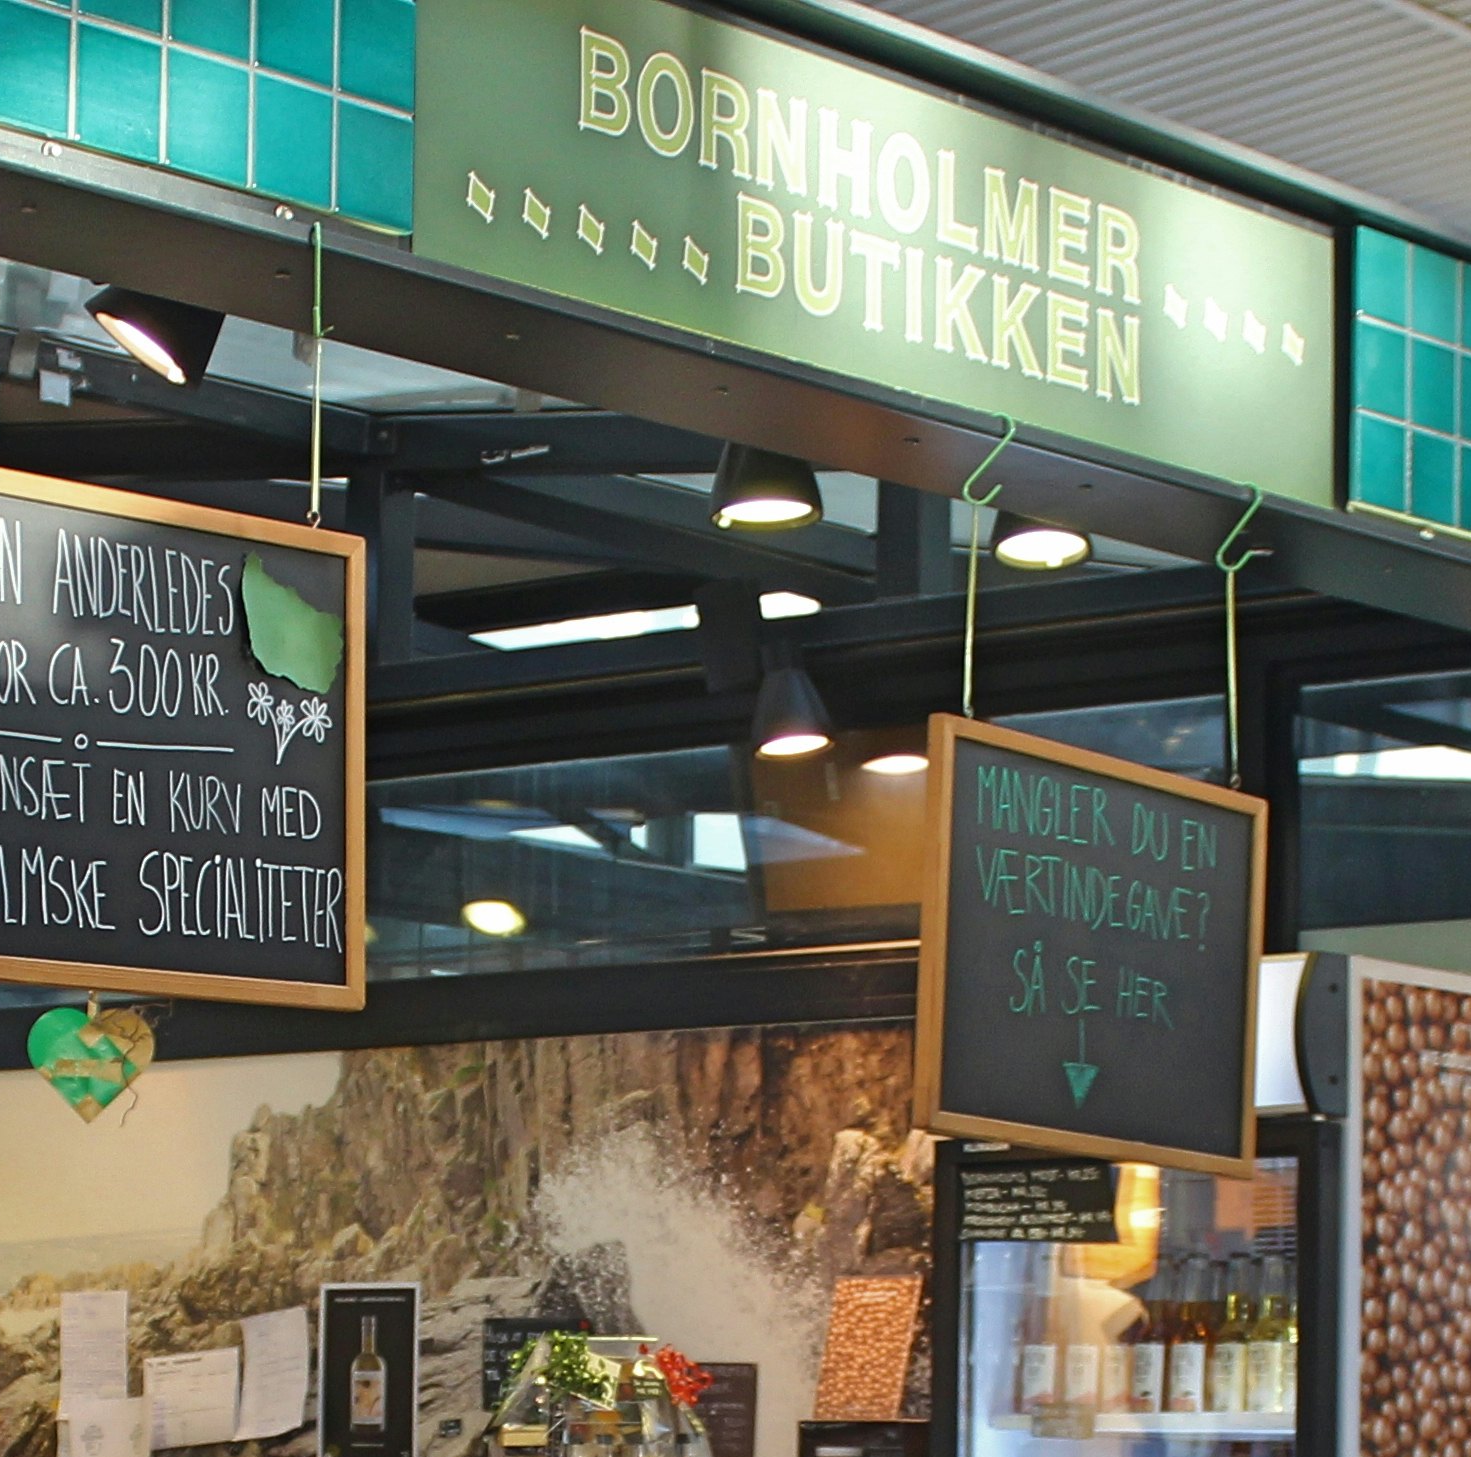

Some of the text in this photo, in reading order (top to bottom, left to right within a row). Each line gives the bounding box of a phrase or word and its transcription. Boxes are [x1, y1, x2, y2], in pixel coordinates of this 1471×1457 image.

[578, 25, 1141, 304] BORNHOLMER
[735, 192, 1140, 405] BUTIKKEN
[52, 528, 234, 637] ANDERLEDES
[48, 642, 99, 707] CA.
[108, 637, 183, 717] 300
[190, 652, 230, 717] KR.
[111, 768, 147, 827] EN
[169, 769, 242, 835] KURV
[260, 786, 322, 841] MED
[976, 765, 1218, 871] MANGLER DU EN
[1009, 940, 1176, 1031] SÅ SE HER
